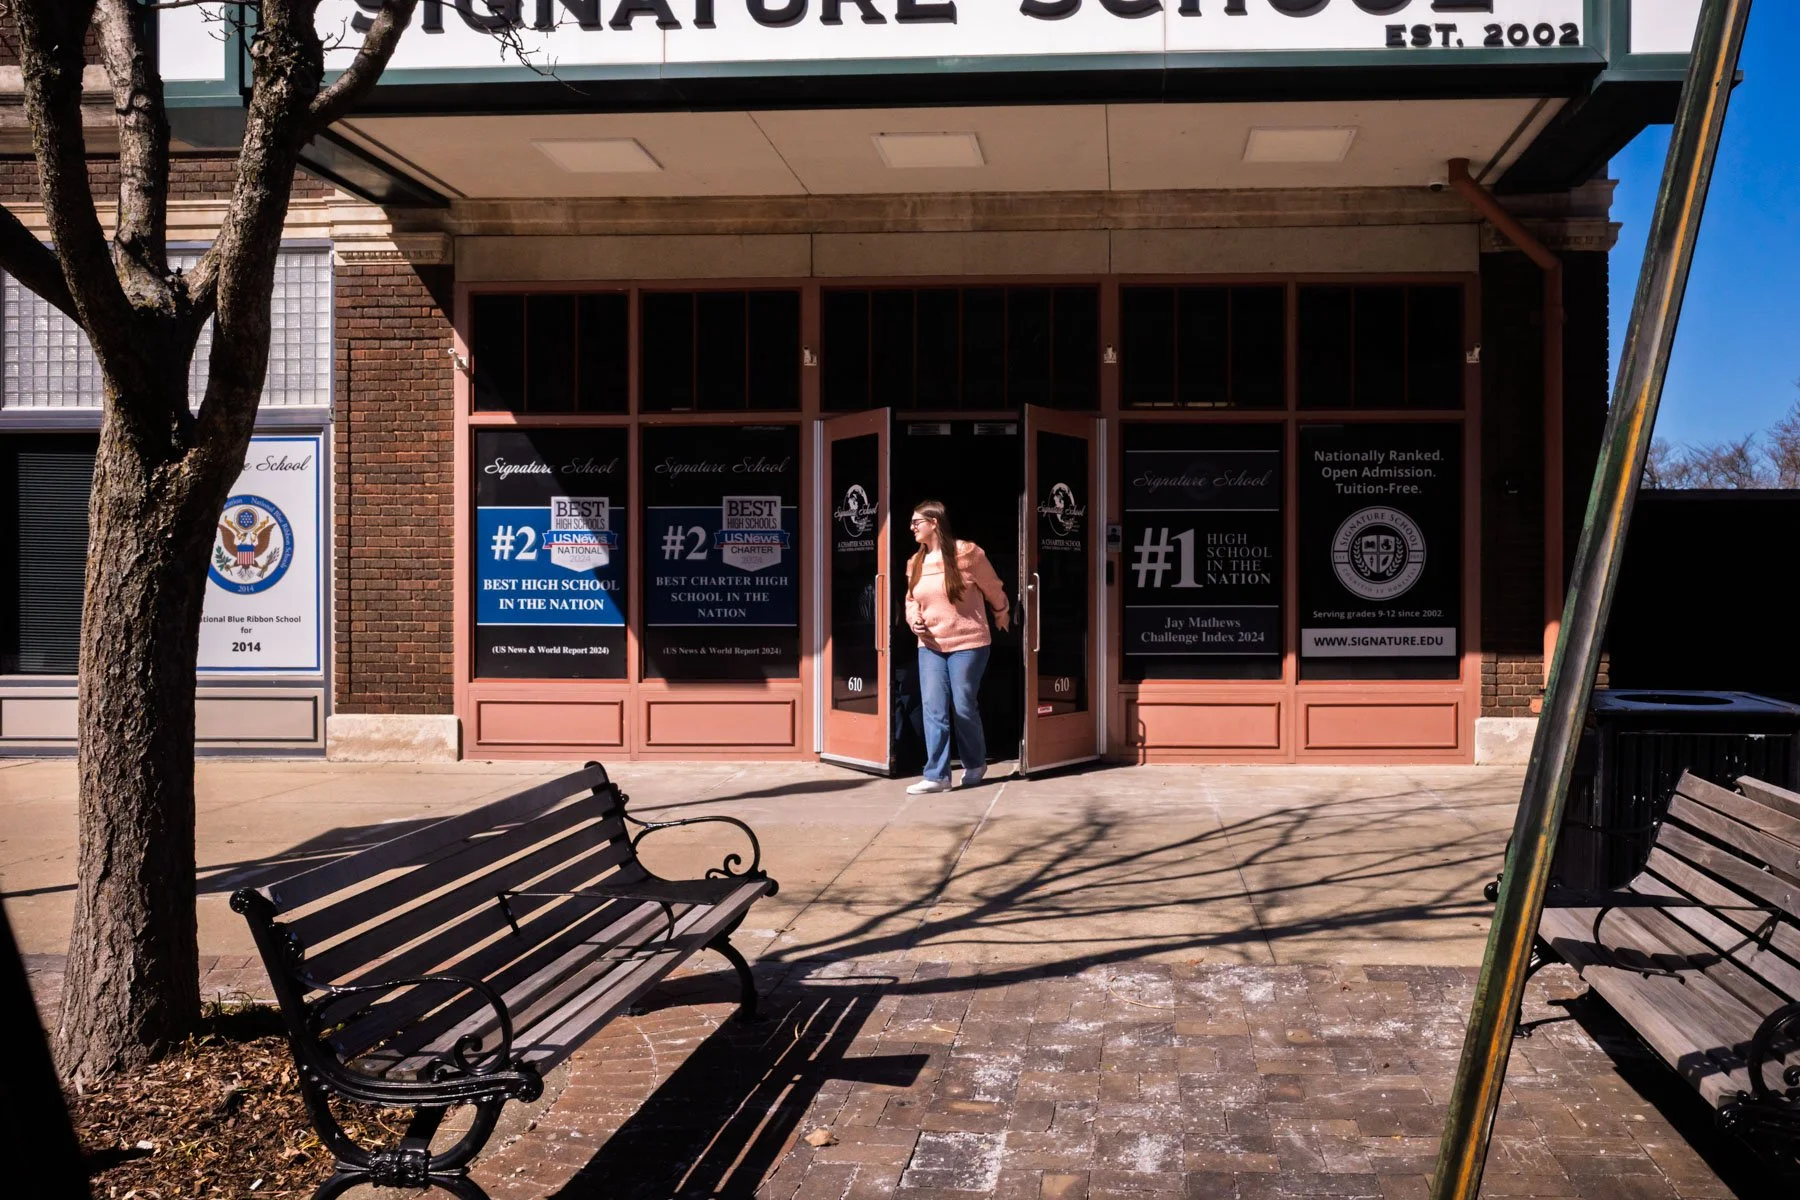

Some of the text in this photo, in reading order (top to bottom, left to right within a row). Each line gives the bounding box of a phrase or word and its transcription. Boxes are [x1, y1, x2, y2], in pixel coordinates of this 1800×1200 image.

[1384, 22, 1581, 48] EST. 2002
[256, 455, 312, 471] School
[1314, 450, 1444, 464] Nationally Ranked.
[484, 457, 619, 480] Signature School
[654, 456, 790, 479] Signature School
[1321, 466, 1436, 480] Open Admission.
[1132, 469, 1273, 493] Signature School
[1336, 482, 1422, 494] Tuition-Free.
[556, 501, 605, 517] BEST
[727, 500, 777, 517] BEST
[556, 518, 605, 530] HIGH SCHOOLS
[727, 517, 777, 530] HIGH SCHOOLS
[490, 525, 538, 561] #2
[661, 525, 708, 561] #2
[1207, 533, 1247, 545] HIGH
[557, 546, 602, 554] NATIONAL
[730, 546, 774, 554] CHARTER
[1206, 546, 1272, 558] SCHOOL
[1131, 527, 1203, 588] #1
[1207, 560, 1262, 571] IN THE
[656, 576, 788, 586] BEST CHARTER HIGH
[1207, 573, 1271, 584] NATION
[483, 579, 620, 591] BEST HIGH SCHOOL
[671, 592, 770, 602] SCHOOL IN THE
[499, 598, 604, 611] IN THE NATION
[201, 615, 302, 623] tional Blue Ribbon School
[697, 608, 746, 618] NATION
[1313, 609, 1444, 619] Serving grades 9-12 since 2002.
[1165, 617, 1241, 630] Jay Mathews
[240, 626, 252, 634] for
[1141, 631, 1264, 644] Challenge Index 2024
[1314, 636, 1444, 647] WWW.SIGNATURE.EDU
[232, 641, 261, 652] 2014
[492, 645, 610, 656] (US News & World Report 2024)
[663, 647, 782, 656] (US News & World Report 2024)
[848, 676, 863, 692] 610
[1054, 677, 1070, 692] 610
